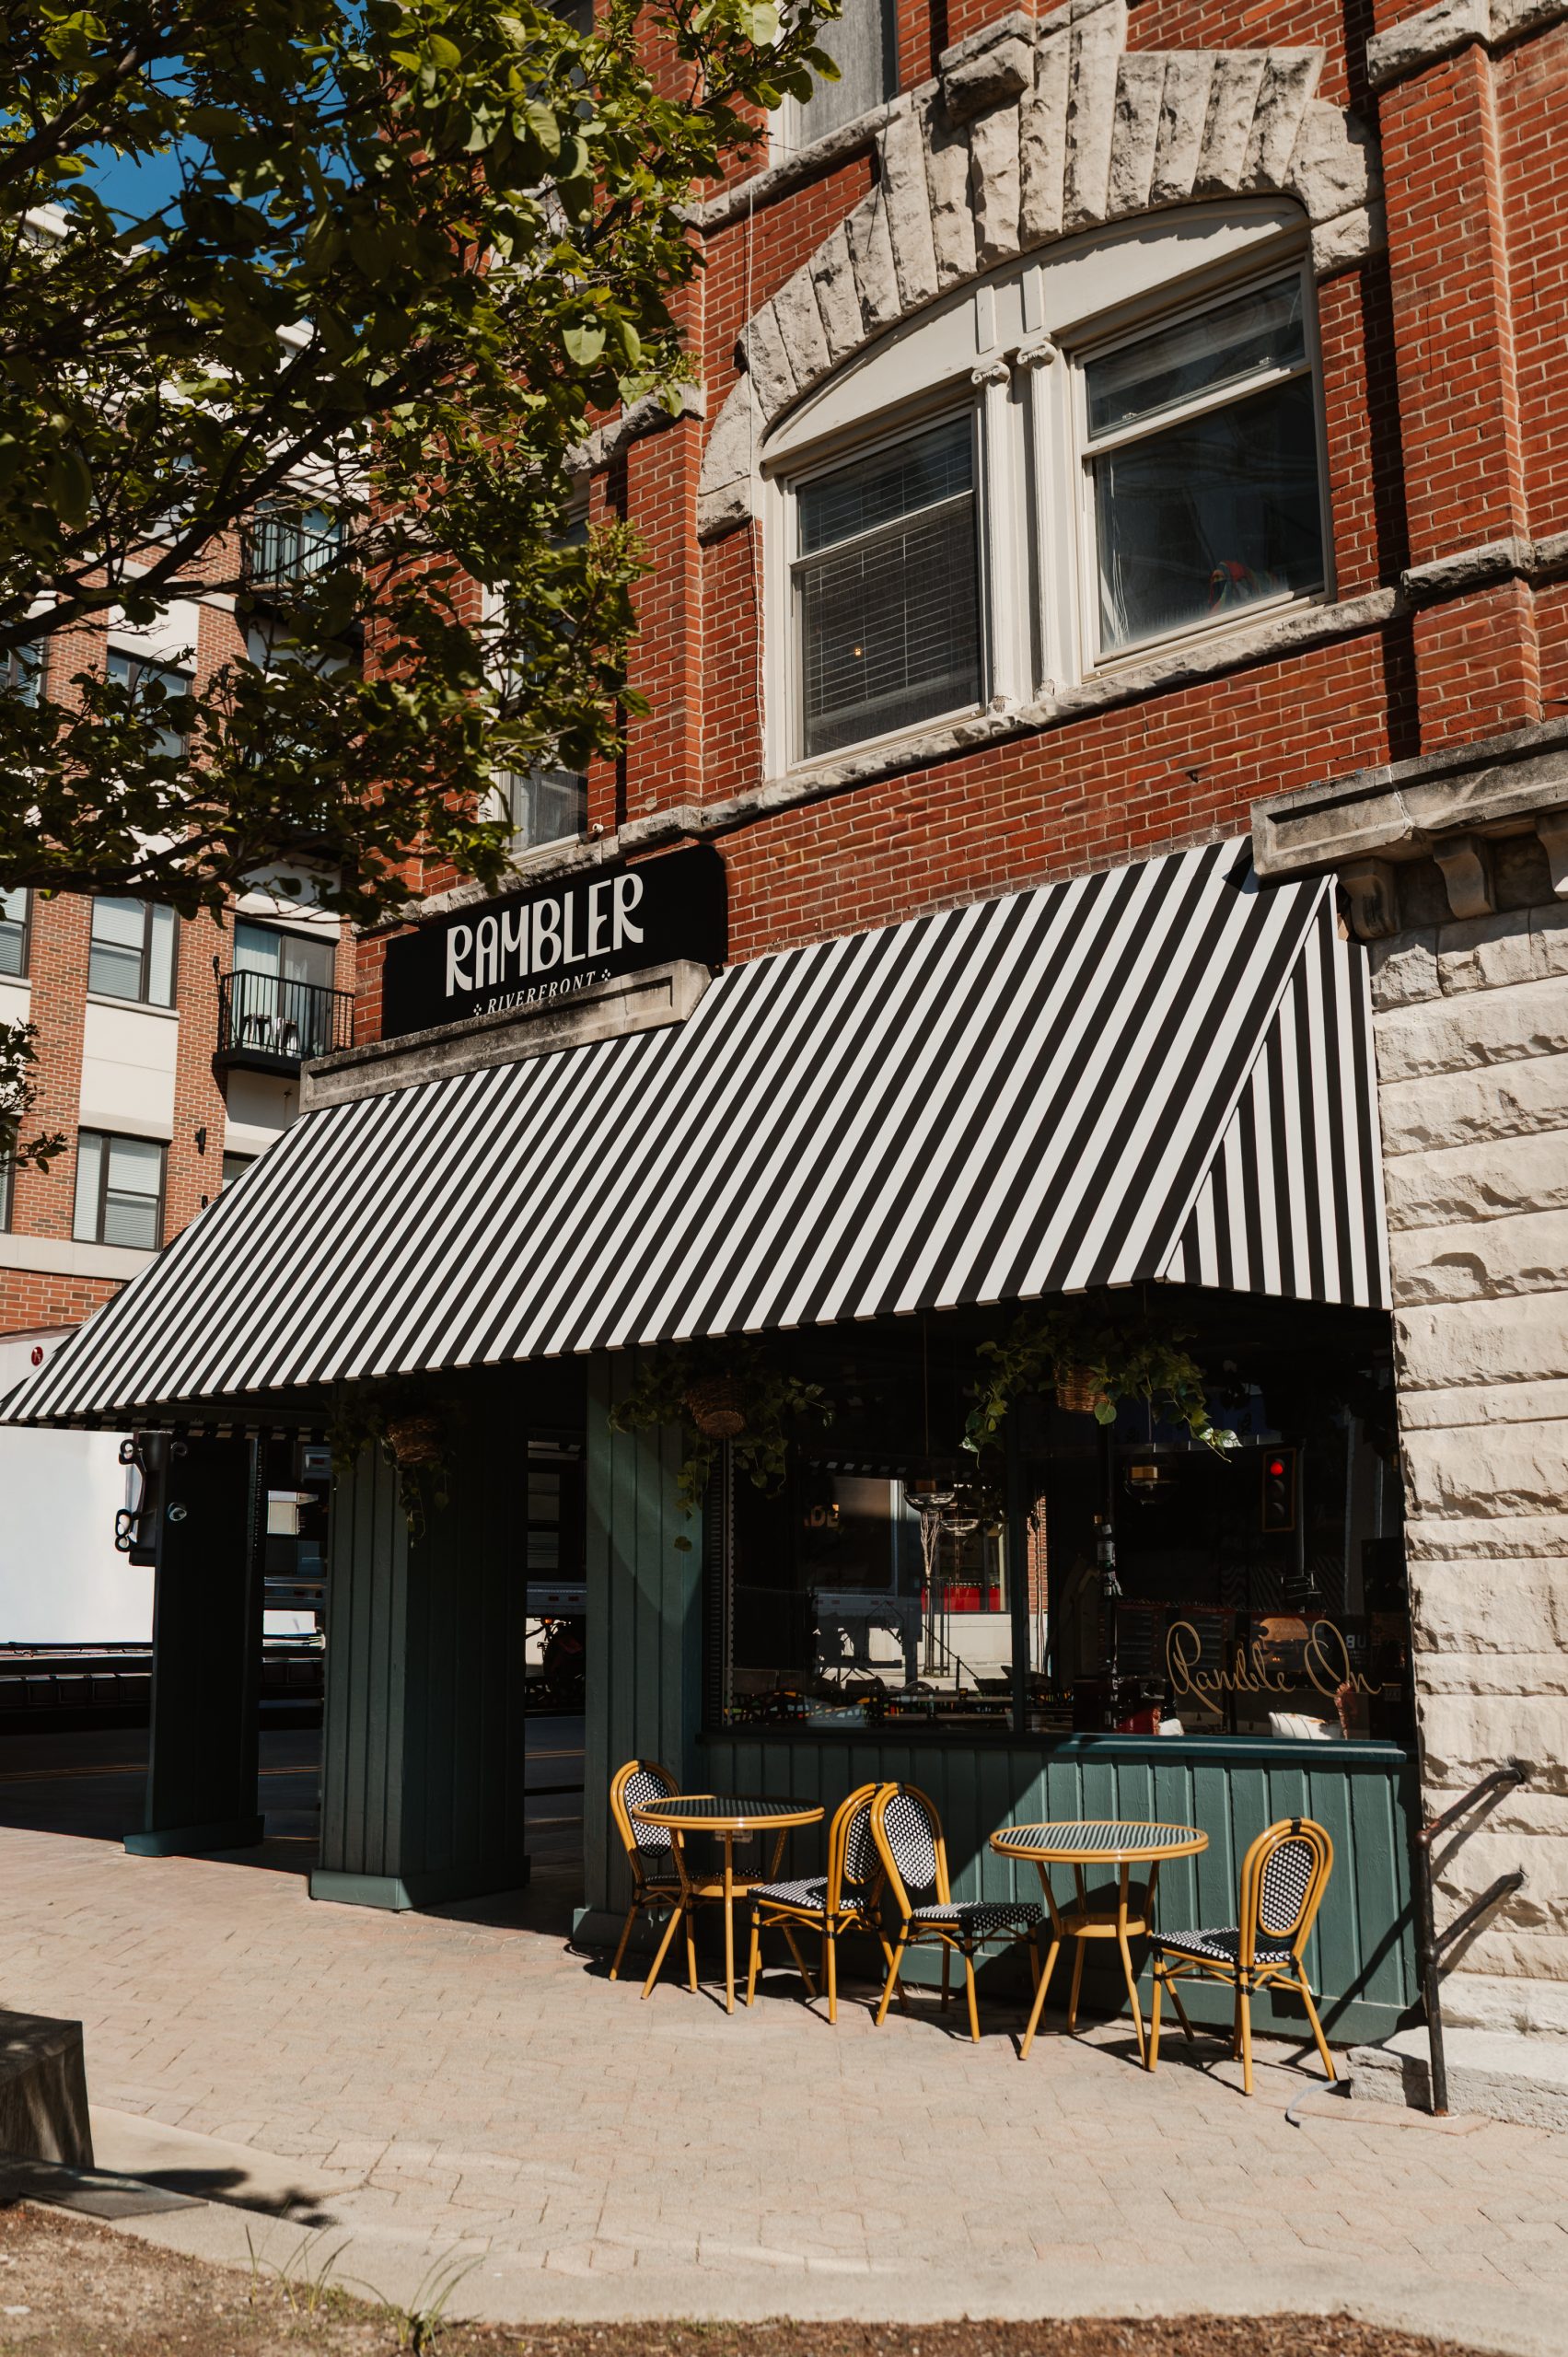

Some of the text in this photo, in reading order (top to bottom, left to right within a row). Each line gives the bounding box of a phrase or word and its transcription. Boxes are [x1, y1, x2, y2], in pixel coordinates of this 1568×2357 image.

[446, 872, 644, 997] RAMBLER
[487, 970, 597, 1014] RIVERFRONT
[1166, 1620, 1382, 1715] Ramble On
